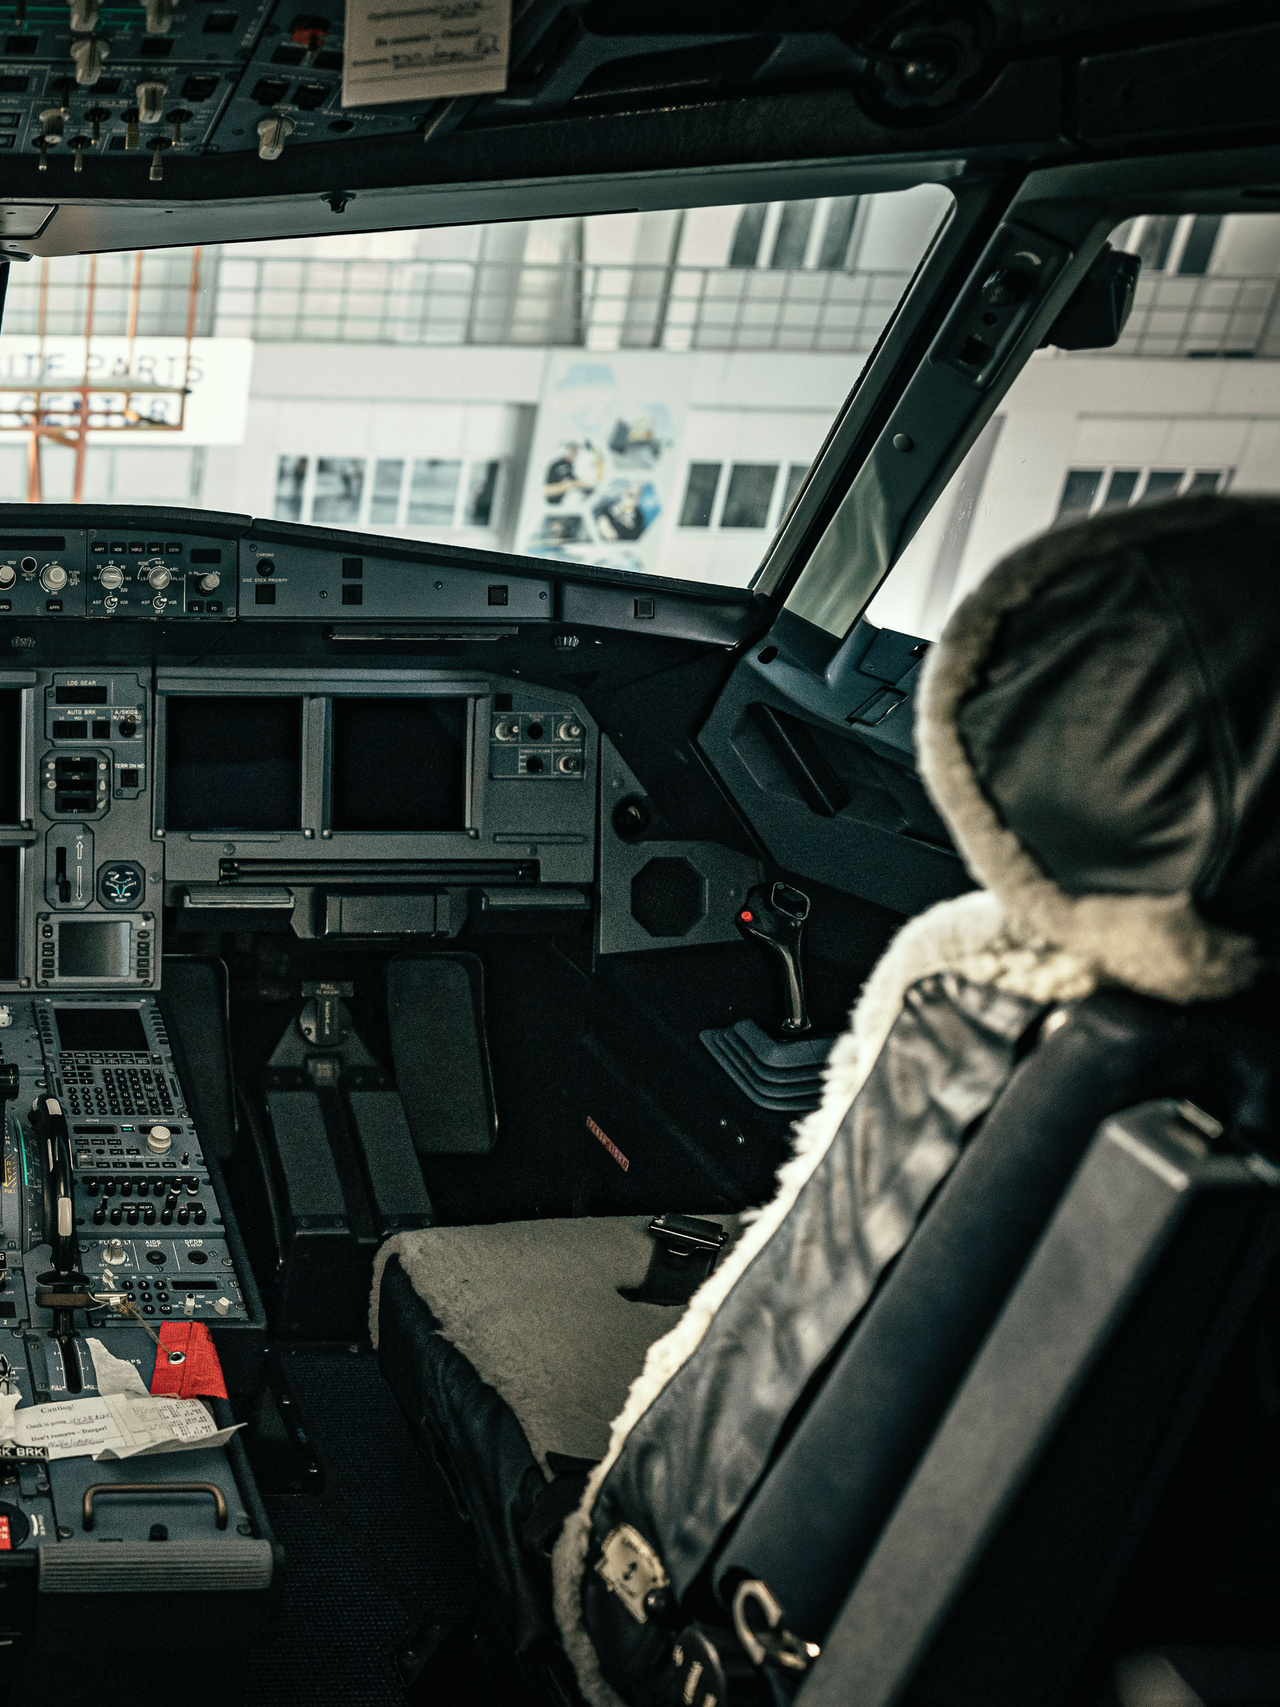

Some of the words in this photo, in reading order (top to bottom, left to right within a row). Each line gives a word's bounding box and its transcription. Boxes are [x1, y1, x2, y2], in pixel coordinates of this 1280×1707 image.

[40, 1403, 75, 1414] Caution!
[51, 1420, 66, 1428] going
[51, 1431, 76, 1439] remove
[82, 1425, 108, 1435] Danger!
[16, 1447, 44, 1456] BRK
